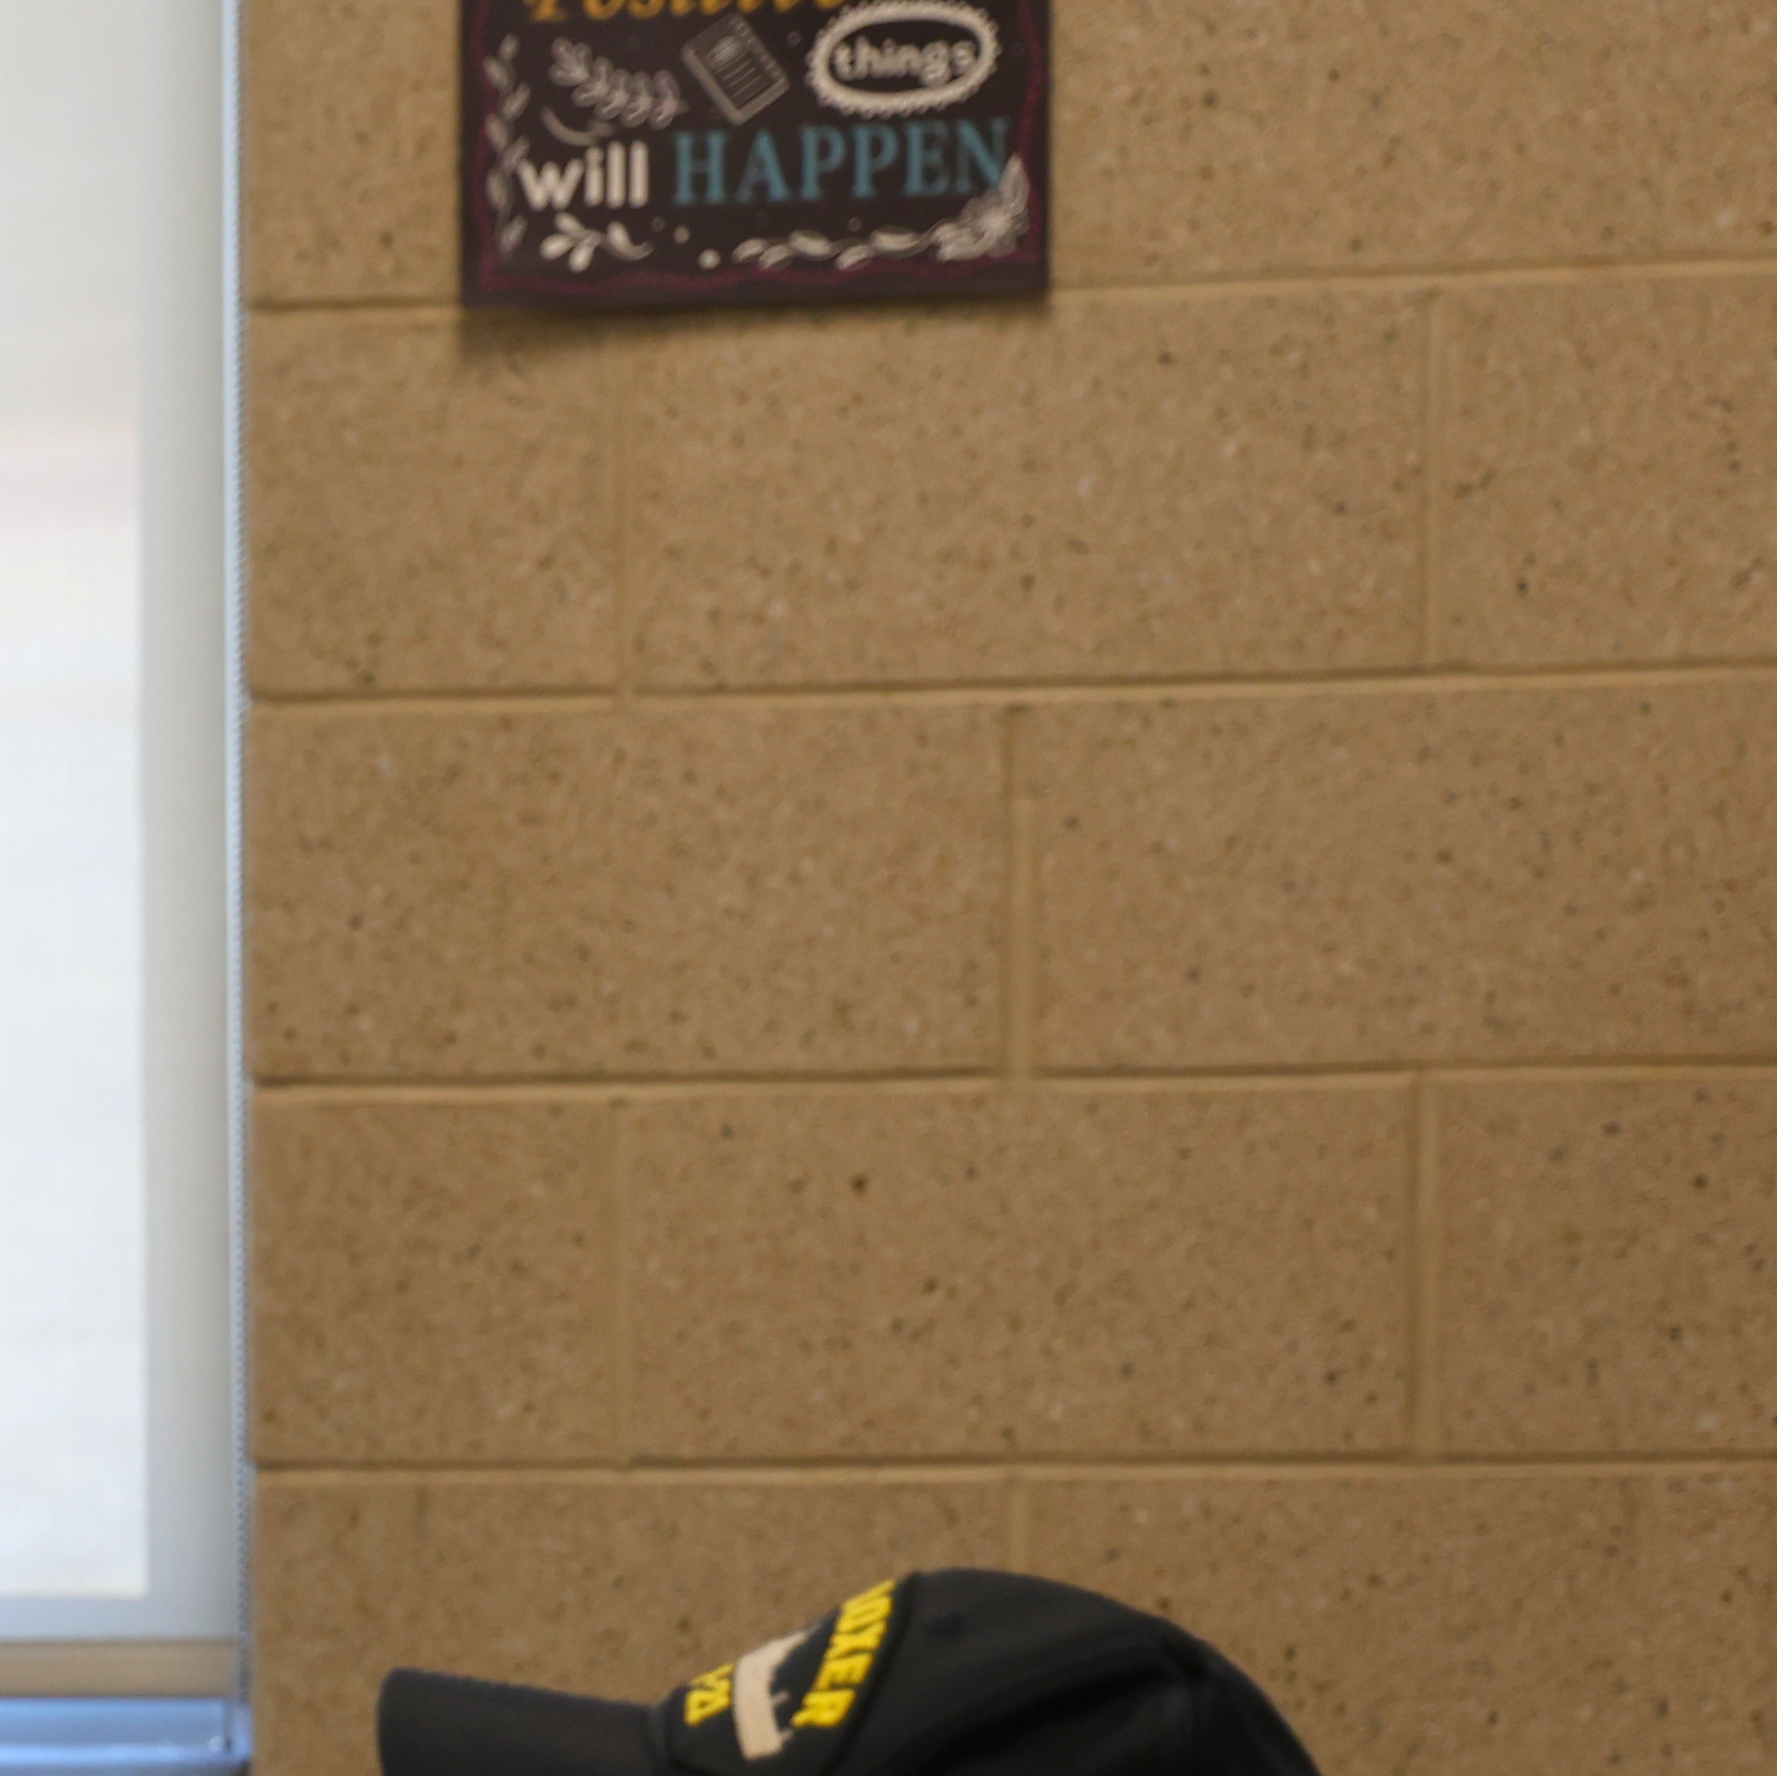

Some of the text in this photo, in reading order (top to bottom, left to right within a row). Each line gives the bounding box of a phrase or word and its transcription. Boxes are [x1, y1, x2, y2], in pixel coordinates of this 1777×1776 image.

[833, 35, 978, 88] things
[517, 116, 1008, 210] will HAPPEN
